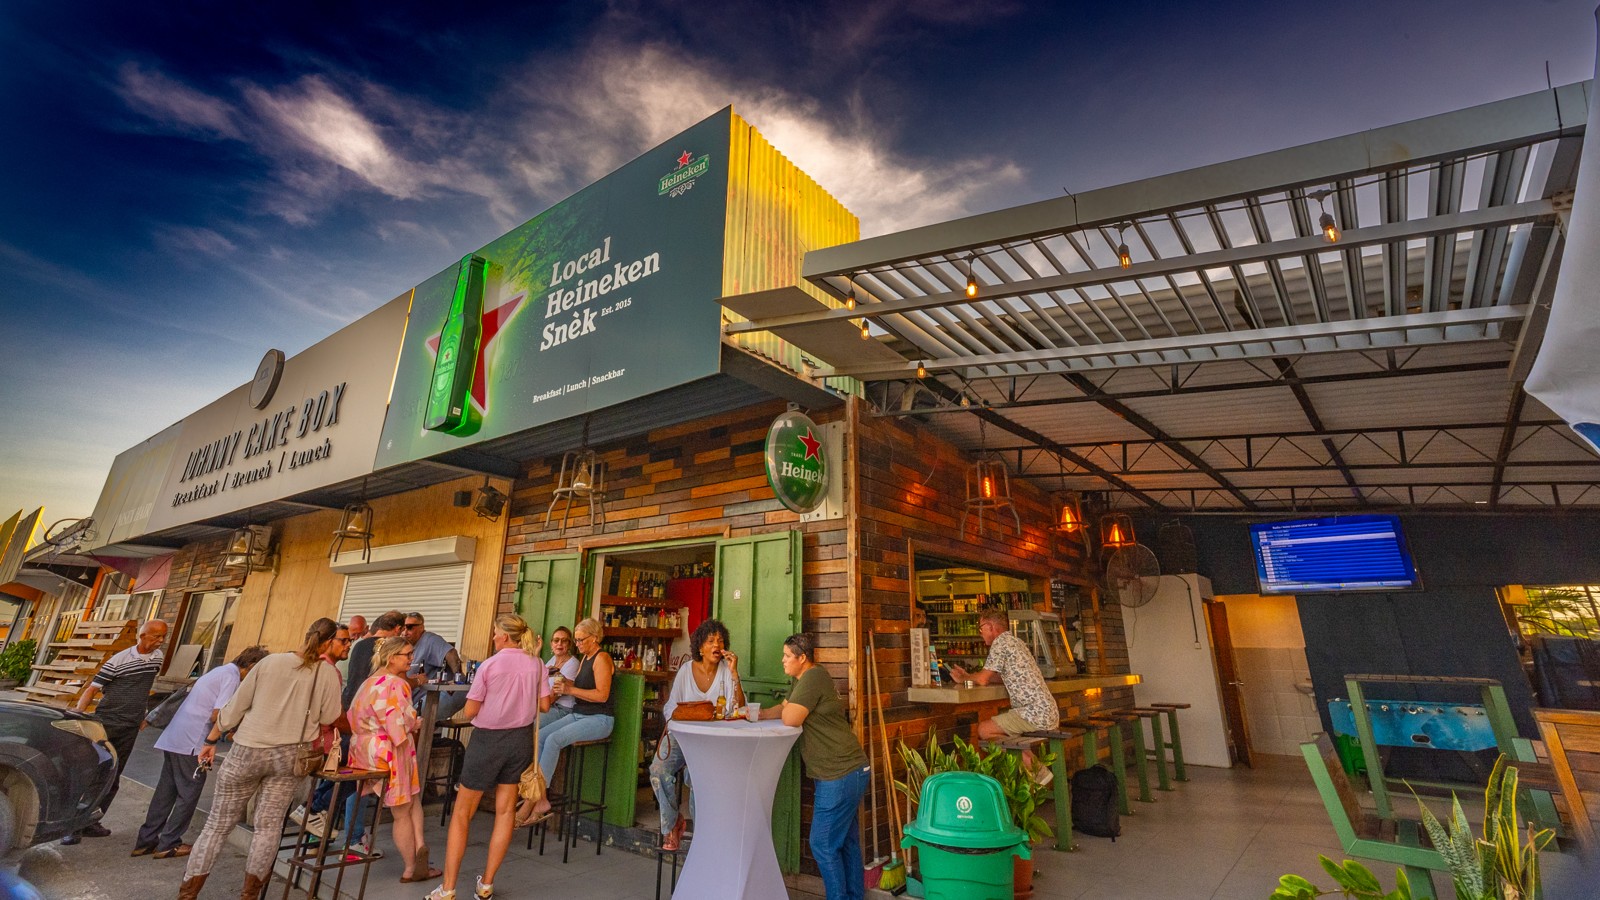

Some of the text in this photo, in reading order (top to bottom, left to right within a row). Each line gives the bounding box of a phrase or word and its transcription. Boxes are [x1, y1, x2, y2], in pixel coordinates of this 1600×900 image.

[661, 161, 706, 190] Heineken
[544, 251, 661, 319] Heineken
[550, 236, 611, 287] Local
[539, 297, 632, 352] Snèk Est. 2015
[532, 387, 562, 404] Breakfast
[566, 378, 587, 394] Lunch
[592, 367, 626, 386] Snackbar
[179, 381, 347, 483] JOHNNY CAKE BOX
[170, 479, 219, 507] Breakfast
[230, 460, 272, 488] Brunch
[288, 438, 333, 470] Lunch
[780, 462, 823, 483] Heinek
